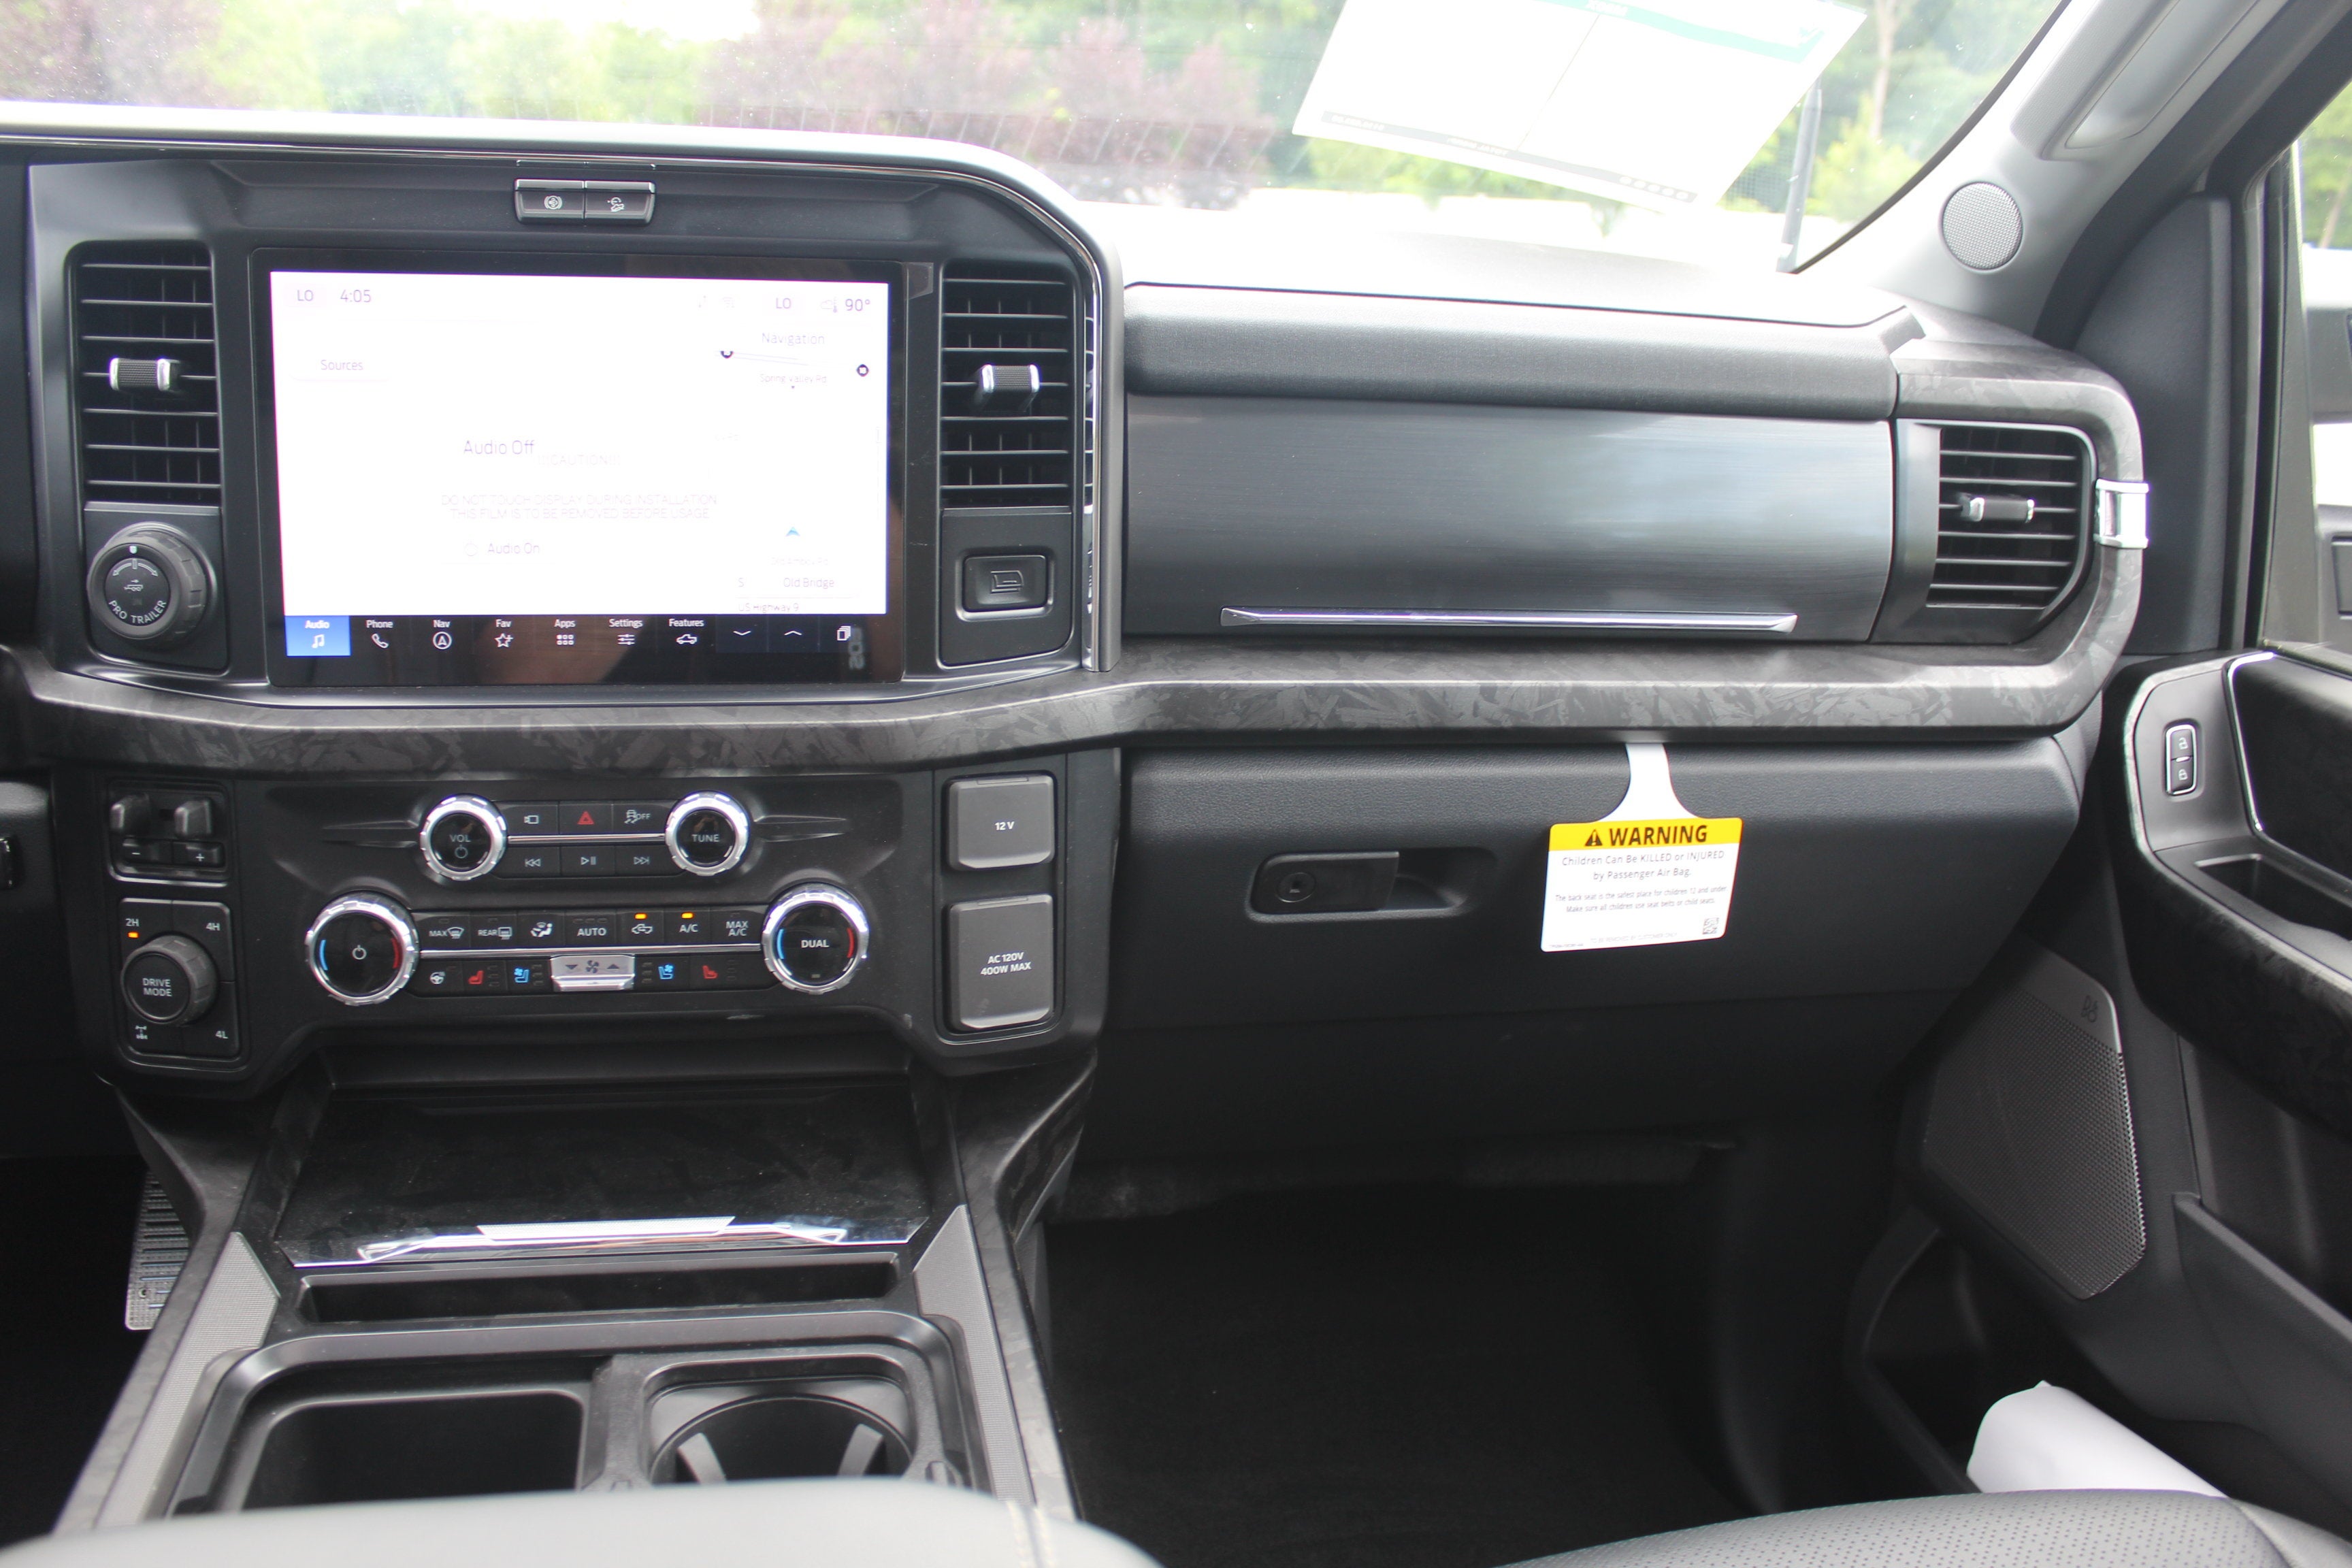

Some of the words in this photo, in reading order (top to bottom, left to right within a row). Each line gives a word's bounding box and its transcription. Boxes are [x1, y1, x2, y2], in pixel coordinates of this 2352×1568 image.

[297, 290, 314, 301] LO
[340, 289, 372, 303] 4:05
[776, 298, 792, 309] LO
[761, 332, 825, 346] Navigation
[320, 359, 363, 370] Sources
[760, 374, 785, 385] Spring
[463, 440, 508, 455] Audio
[512, 440, 535, 455] Off
[441, 494, 459, 506] DO
[461, 494, 487, 506] NOT
[490, 494, 531, 506] TOUCH
[534, 494, 583, 506] DISPLAY
[587, 494, 632, 506] DURING
[636, 494, 717, 505] INSTALLATION
[449, 508, 476, 520] THIS
[480, 508, 507, 520] FILM
[510, 508, 521, 520] IS
[525, 508, 539, 520] TO
[543, 508, 557, 520] BE
[561, 508, 619, 520] REMOVED
[622, 508, 668, 520] BEFORE
[671, 508, 710, 520] USAGE
[487, 543, 521, 555] Audio
[524, 543, 540, 555] On
[783, 577, 800, 588] Old
[803, 577, 834, 589] Bridge
[109, 600, 128, 620] PRO
[131, 600, 166, 625] TRAILER
[738, 603, 751, 612] US
[753, 603, 791, 614] Highway
[794, 603, 799, 611] 9
[305, 621, 329, 629] Audio
[366, 619, 393, 629] Phone
[433, 619, 451, 629] Nav
[495, 619, 512, 629] Fav
[554, 619, 576, 630] Apps
[609, 619, 644, 630] Settings
[668, 619, 704, 627] Features
[637, 813, 650, 821] OFF
[995, 822, 1006, 830] 12
[1007, 821, 1015, 830] V
[449, 834, 471, 843] VOL
[691, 834, 720, 843] TUNE
[1609, 825, 1708, 847] WARNING
[1562, 855, 1602, 866] Children
[1605, 855, 1622, 864] Can
[1626, 853, 1637, 863] Be
[1640, 852, 1671, 862] KILLED
[1686, 850, 1725, 860] INJURED
[1592, 870, 1603, 882] by
[1607, 870, 1655, 882] Passenger
[1656, 868, 1671, 877] Air
[125, 919, 139, 927] 2H
[206, 921, 220, 931] 4H
[679, 924, 698, 932] A/C
[429, 929, 446, 937] MAX
[577, 928, 606, 936] AUTO
[728, 928, 747, 936] A/C
[800, 939, 829, 948] DUAL
[988, 956, 1000, 964] AC
[1002, 951, 1024, 962] 120V
[980, 965, 1009, 976] 400W
[1010, 962, 1032, 973] MAX
[143, 979, 172, 987] DRIVE
[143, 987, 172, 996] MODE
[215, 1030, 229, 1040] 4L
